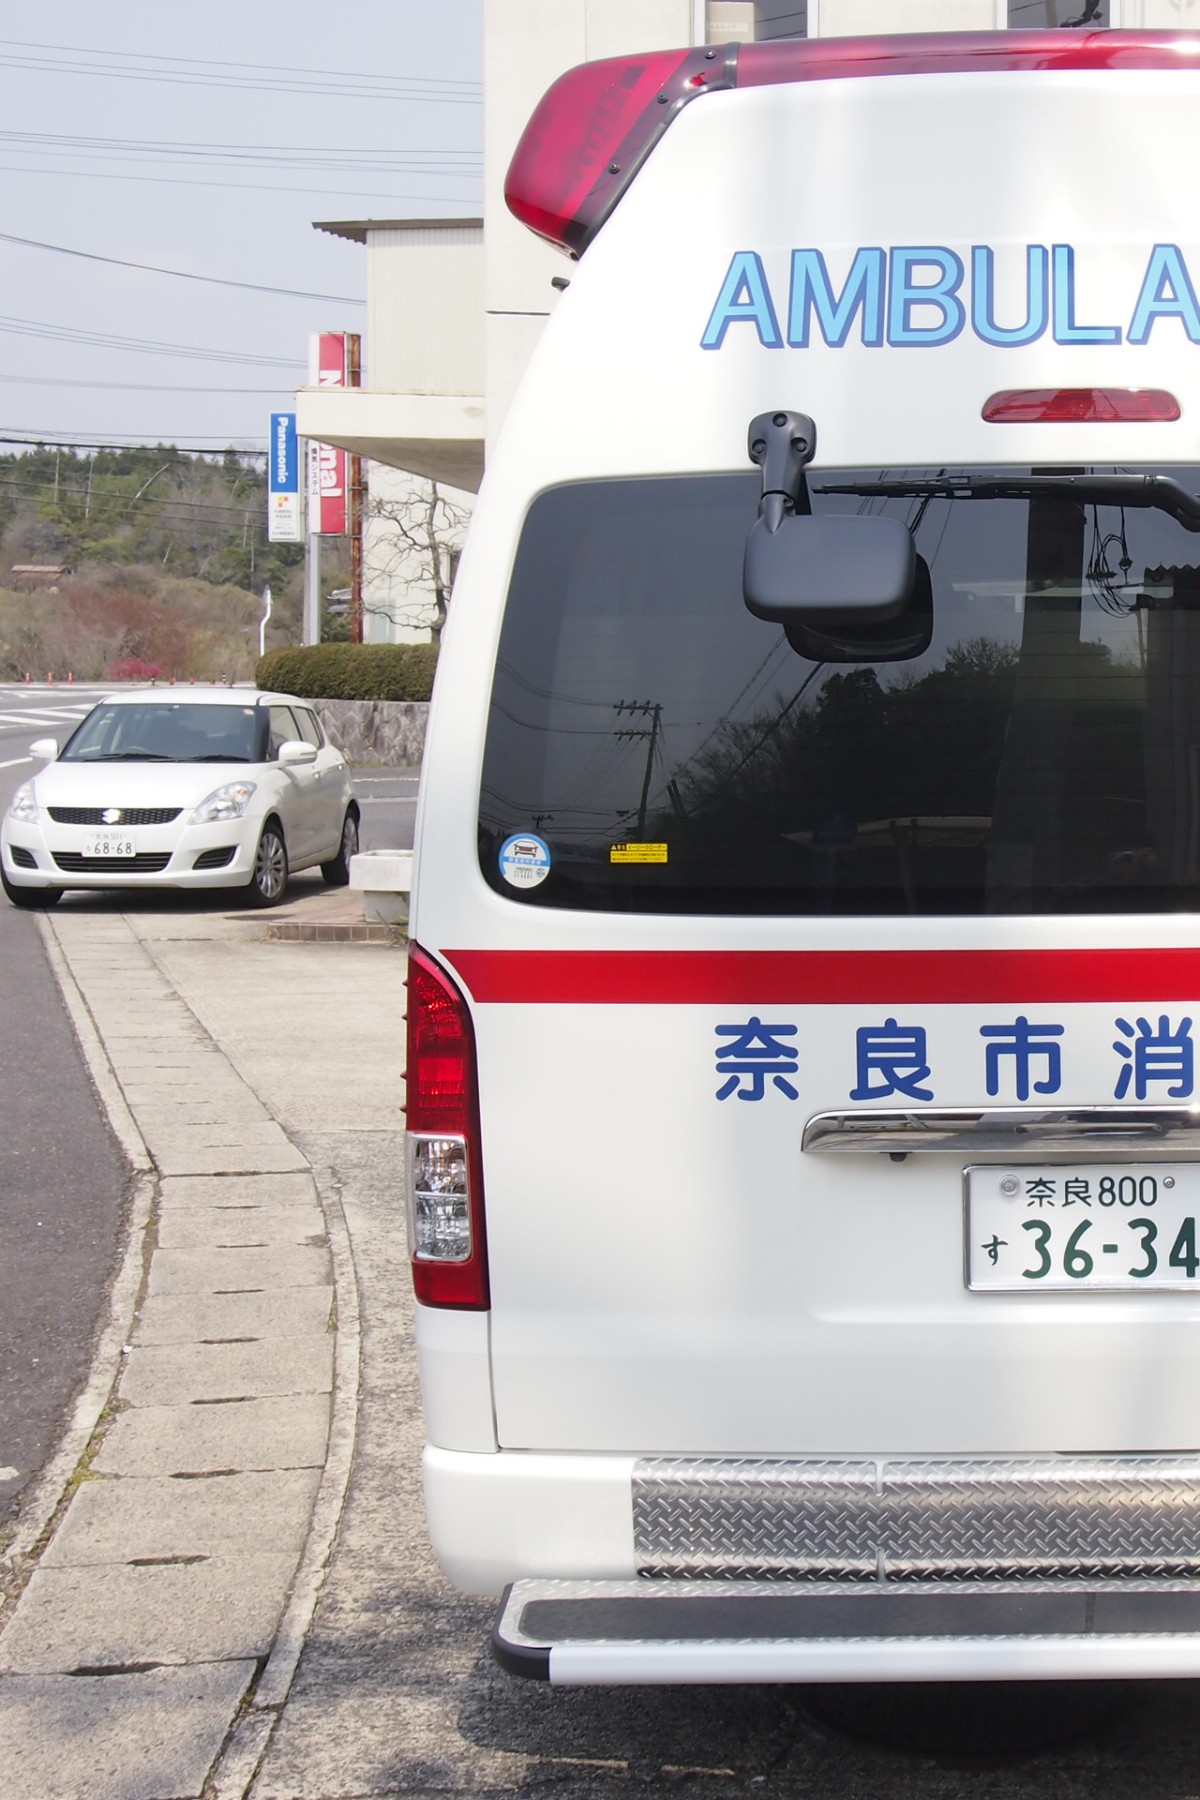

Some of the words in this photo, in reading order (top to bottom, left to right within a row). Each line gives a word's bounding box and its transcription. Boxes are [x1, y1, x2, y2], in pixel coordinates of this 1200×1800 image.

[277, 416, 289, 484] Panasonic
[94, 842, 132, 854] 68-68
[1025, 1176, 1158, 1208] 奈良800
[981, 1234, 1008, 1266] す
[1021, 1217, 1200, 1279] 36-34
